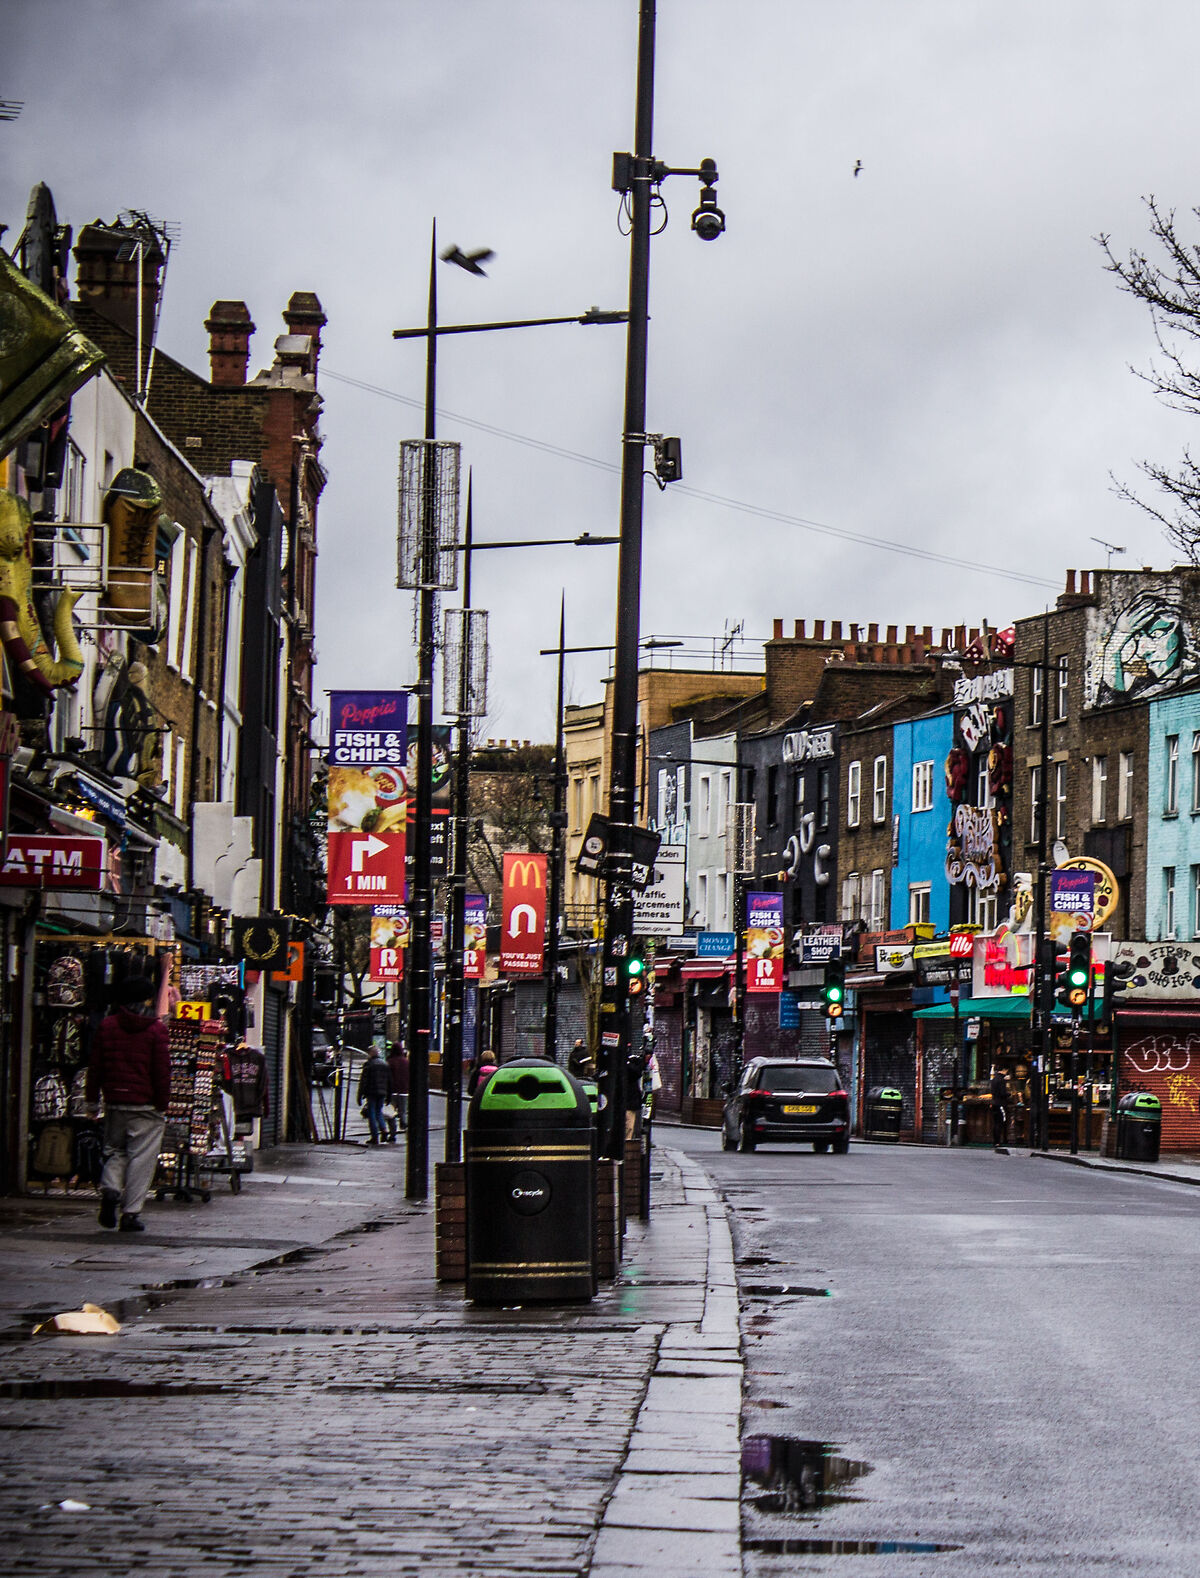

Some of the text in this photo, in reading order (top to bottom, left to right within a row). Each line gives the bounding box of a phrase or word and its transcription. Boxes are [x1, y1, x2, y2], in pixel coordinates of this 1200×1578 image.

[341, 699, 397, 729] Poppies
[335, 733, 400, 747] FISH &
[335, 748, 401, 762] CHIPS
[1, 848, 83, 877] ATM
[345, 876, 387, 890] 1 MIN
[1054, 894, 1091, 902] FISH &
[1054, 902, 1091, 910] CHIPS
[803, 938, 839, 946] LEATHER
[950, 936, 973, 955] illy
[811, 947, 833, 955] SHOP
[1149, 946, 1192, 961] FIRST
[1148, 971, 1193, 988] CHOICE
[180, 1004, 205, 1020] £1
